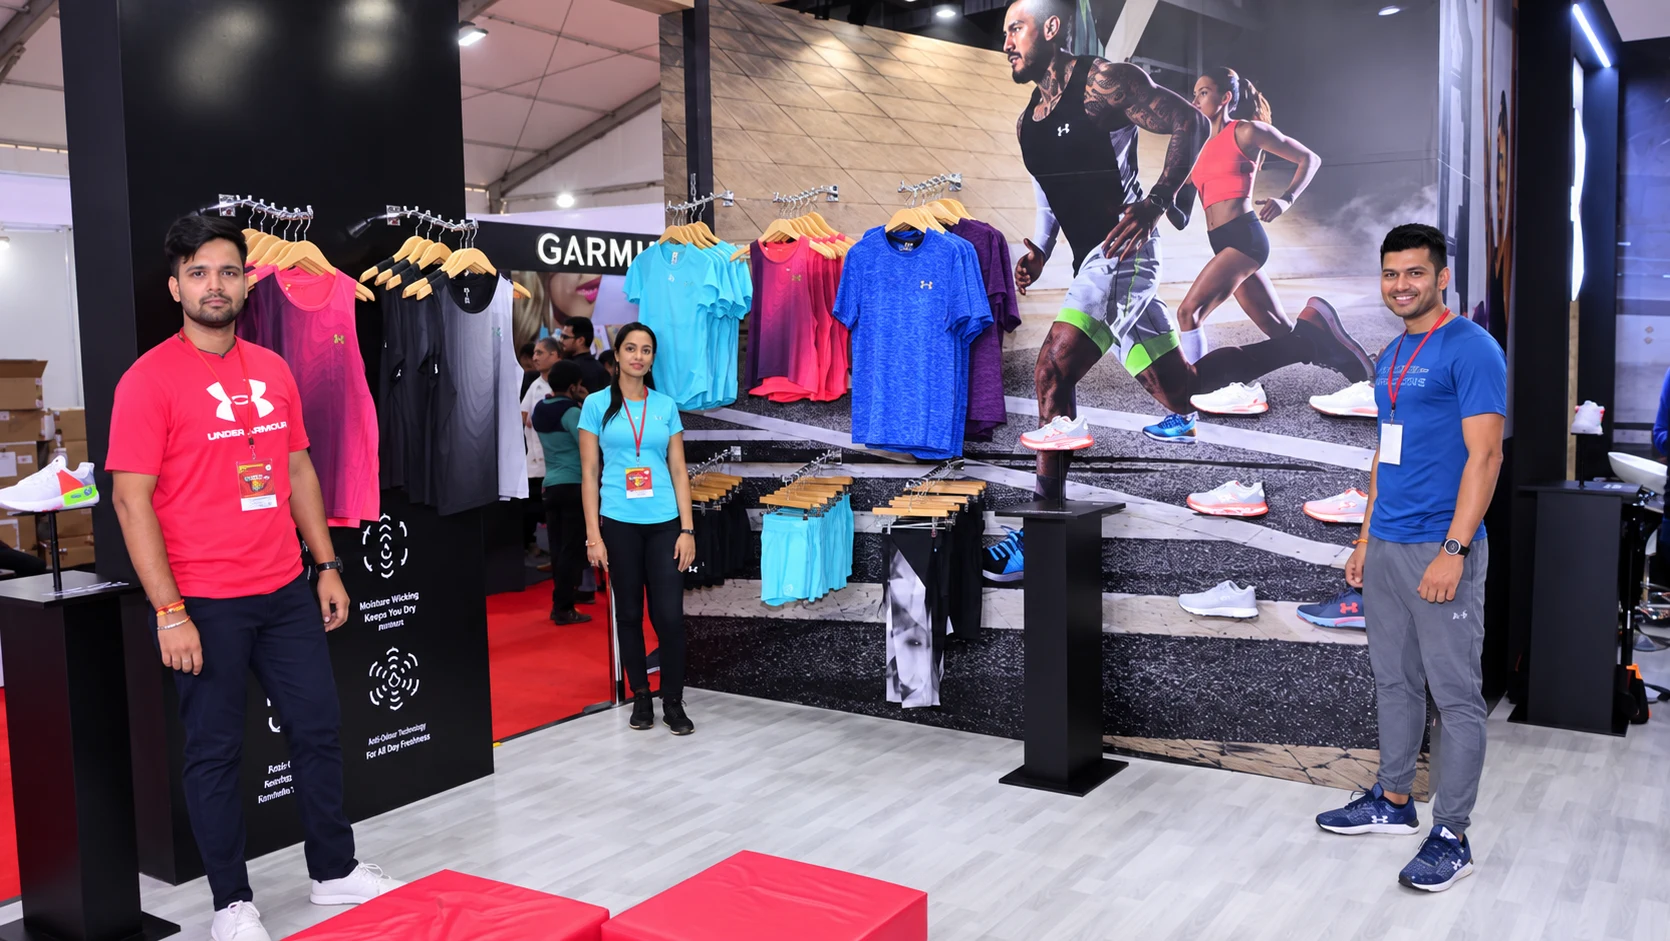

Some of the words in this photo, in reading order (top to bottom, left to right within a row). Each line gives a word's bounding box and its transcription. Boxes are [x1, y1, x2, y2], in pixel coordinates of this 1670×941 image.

[537, 232, 656, 268] GARM
[207, 428, 245, 441] UNDER
[388, 608, 403, 617] You
[403, 605, 417, 615] Dry
[366, 750, 377, 760] For
[377, 745, 387, 756] All
[387, 743, 400, 753] Day
